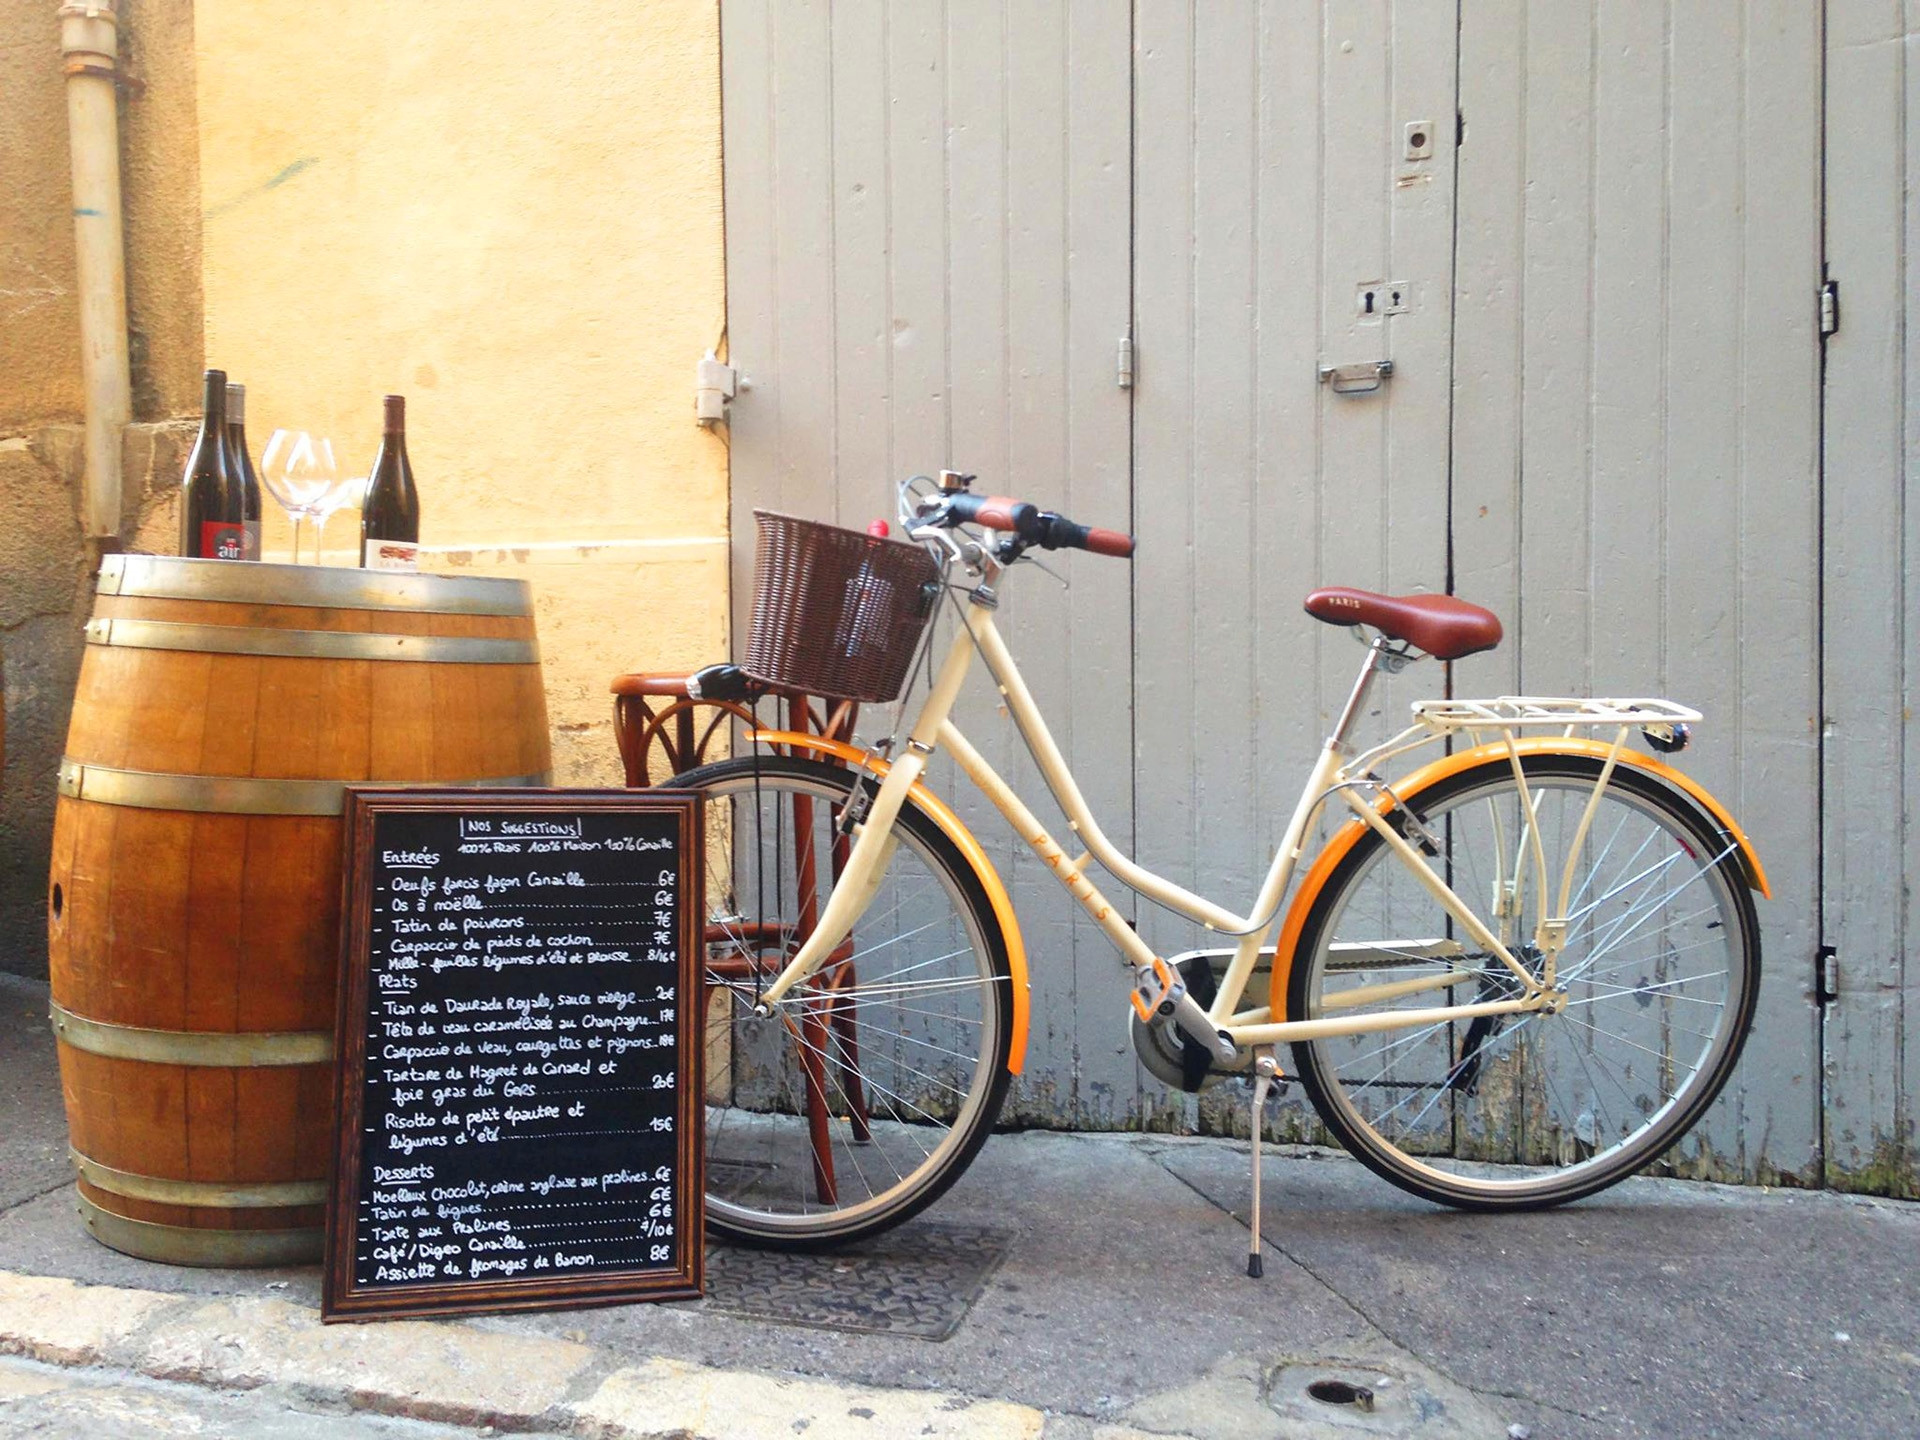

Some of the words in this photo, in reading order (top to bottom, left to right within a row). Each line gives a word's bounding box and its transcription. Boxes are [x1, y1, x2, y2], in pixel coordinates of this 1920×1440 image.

[218, 544, 240, 558] air
[1329, 597, 1360, 608] PARIS
[468, 820, 491, 832] NOS
[382, 846, 440, 864] Entrées
[391, 876, 436, 897] Oeufs
[484, 874, 521, 893] façon
[527, 871, 586, 887] Canaille
[658, 870, 675, 886] 6€
[1031, 834, 1110, 921] PARIS
[392, 898, 408, 911] Os
[417, 899, 426, 912] à
[434, 894, 484, 911] moëlle
[654, 890, 674, 906] 6€
[391, 918, 432, 933] Tatin
[438, 918, 458, 931] de
[463, 917, 524, 935] poivrons
[653, 911, 672, 927] 7€
[391, 938, 458, 957] Carpaccio
[462, 938, 481, 950] de
[487, 935, 522, 953] pieds
[525, 934, 542, 948] de
[547, 934, 594, 946] cochon
[653, 931, 671, 945] 7€
[569, 953, 583, 964] et
[379, 974, 418, 989] Plats
[382, 1001, 415, 1015] Tian
[420, 1002, 438, 1014] de
[444, 997, 503, 1013] Daurade
[558, 994, 591, 1006] sauce
[381, 1021, 413, 1037] Tête
[417, 1021, 436, 1036] de
[442, 1023, 470, 1034] veau
[559, 1019, 577, 1029] au
[582, 1014, 648, 1032] Champagne
[383, 1042, 449, 1064] Carpaccio
[454, 1042, 473, 1055] de
[587, 1036, 602, 1048] et
[607, 1037, 653, 1054] pignons
[383, 1068, 441, 1082] Tartare
[445, 1067, 464, 1080] de
[523, 1063, 539, 1075] de
[542, 1059, 591, 1075] Canard
[598, 1060, 618, 1074] et
[392, 1087, 424, 1107] foie
[431, 1087, 467, 1106] gras
[472, 1084, 495, 1097] du
[652, 1072, 675, 1089] 20€
[384, 1112, 436, 1129] Risotto
[442, 1111, 460, 1125] de
[466, 1107, 500, 1131] petit
[568, 1100, 585, 1117] et
[650, 1116, 673, 1132] 15€
[373, 1163, 435, 1183] Desserts
[373, 1187, 427, 1203] Moelleux
[580, 1177, 598, 1187] aux
[654, 1165, 672, 1182] 6€
[371, 1206, 407, 1221] Tatin
[411, 1205, 430, 1217] de
[650, 1186, 672, 1201] 6€
[372, 1225, 410, 1242] Tarte
[417, 1226, 443, 1238] aux
[453, 1218, 511, 1235] Pralines
[649, 1203, 672, 1218] 6€
[468, 1234, 526, 1251] Canaille
[375, 1262, 436, 1281] Assiette
[443, 1261, 462, 1275] de
[468, 1257, 528, 1278] fromages
[533, 1254, 550, 1269] de
[650, 1245, 670, 1261] 8€
